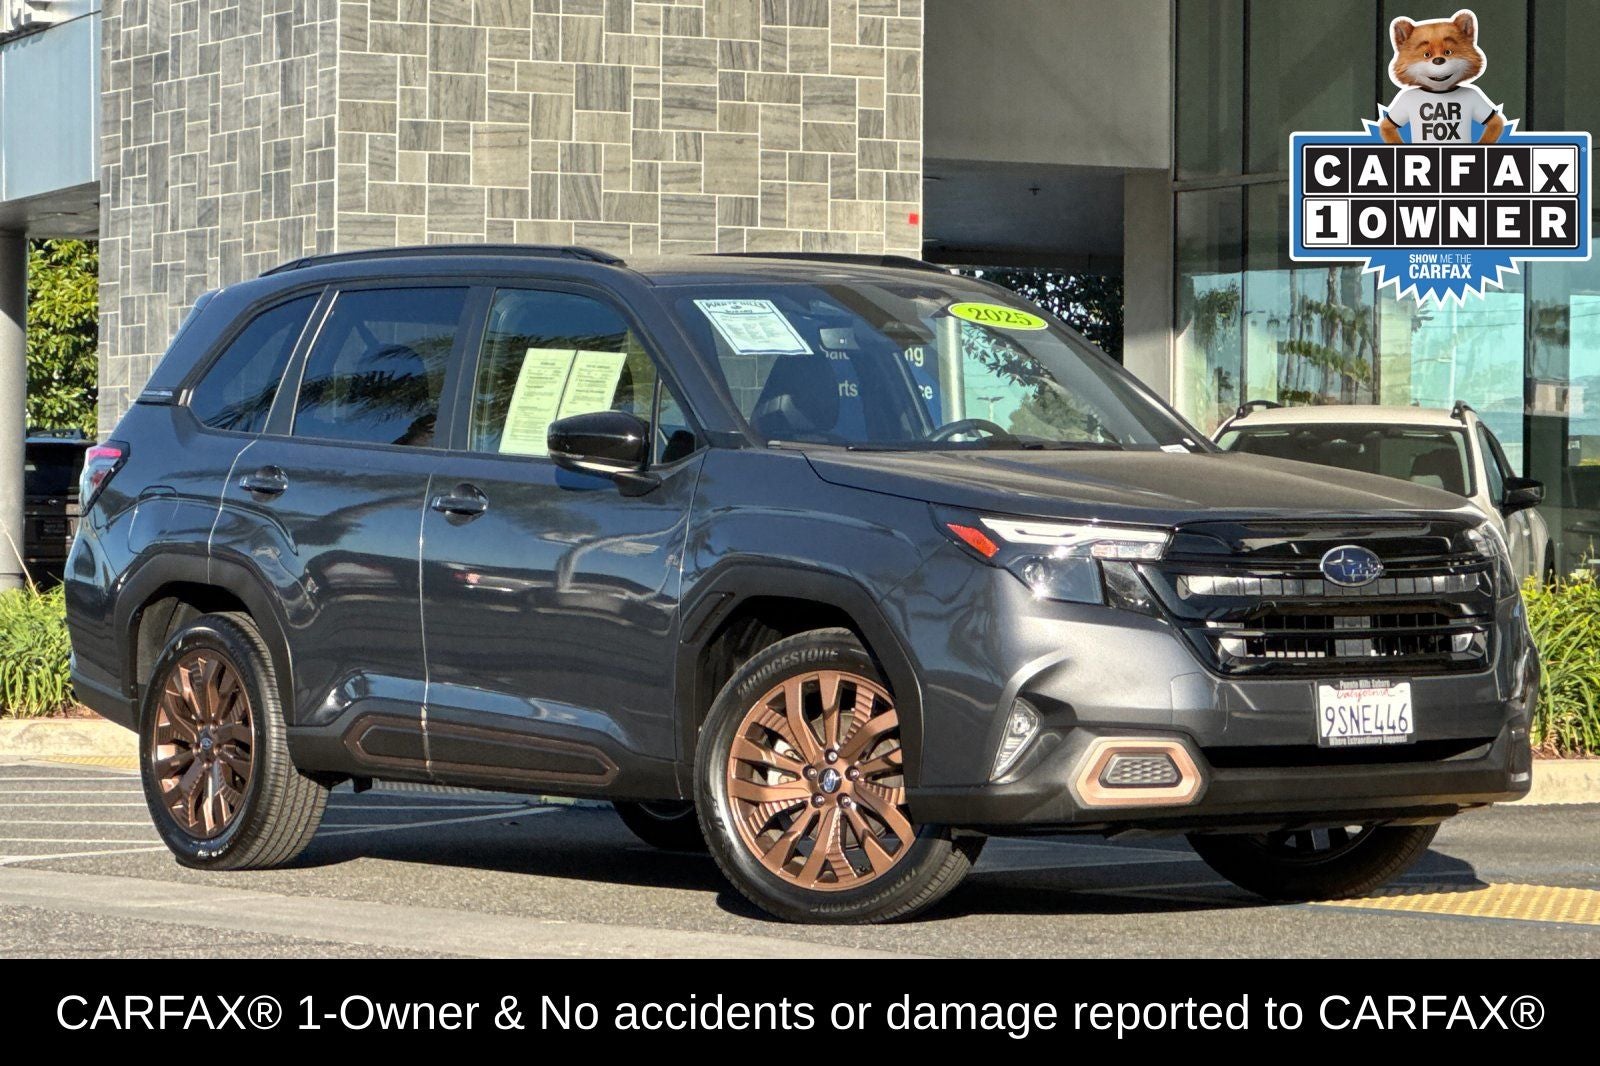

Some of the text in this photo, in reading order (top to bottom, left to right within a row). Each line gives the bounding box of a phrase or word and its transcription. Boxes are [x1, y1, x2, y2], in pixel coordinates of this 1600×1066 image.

[967, 307, 1032, 326] 2025
[838, 380, 859, 397] rts
[1325, 703, 1408, 736] 9SNE446
